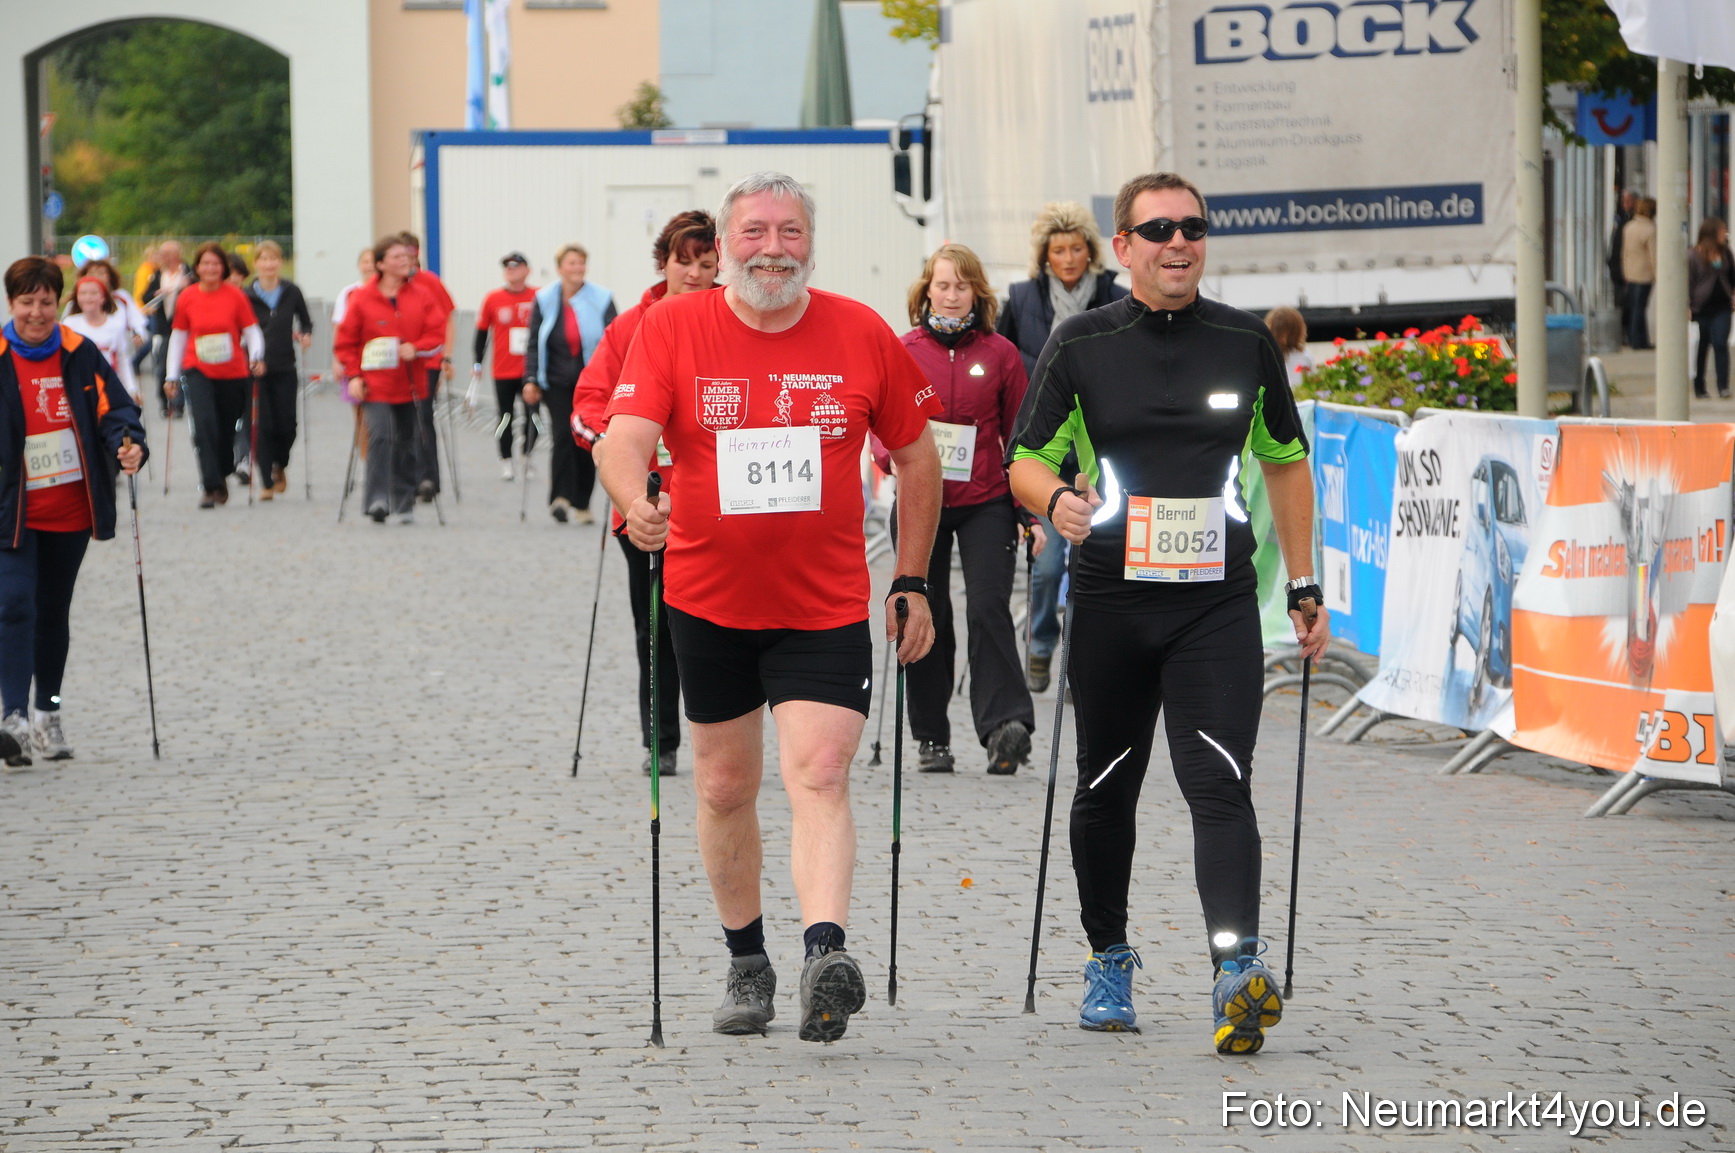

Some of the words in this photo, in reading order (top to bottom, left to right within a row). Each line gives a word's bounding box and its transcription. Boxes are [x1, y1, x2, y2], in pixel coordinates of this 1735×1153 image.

[1195, 0, 1480, 64] BOCK
[1214, 80, 1296, 94] Entwicklung
[1215, 115, 1333, 131] Kunststofftechnik
[1216, 132, 1363, 149] Aluminium-Druckguss
[1217, 154, 1268, 170] Logistik
[1209, 193, 1475, 229] www.bockonline.de
[768, 374, 781, 382] 11.
[783, 374, 844, 383] NEUMARKTER
[781, 381, 833, 390] STADTLAUF
[703, 386, 740, 394] IMMER
[702, 395, 741, 403] WIEDER
[703, 404, 739, 416] NEU
[703, 417, 739, 425] MARKT
[729, 434, 791, 453] Heinrich
[31, 449, 73, 471] 8015
[937, 444, 967, 461] 079
[748, 459, 813, 485] 8114
[1157, 504, 1196, 521] Bernd
[1157, 530, 1219, 554] 8052
[1189, 567, 1223, 576] PFLEIDERER
